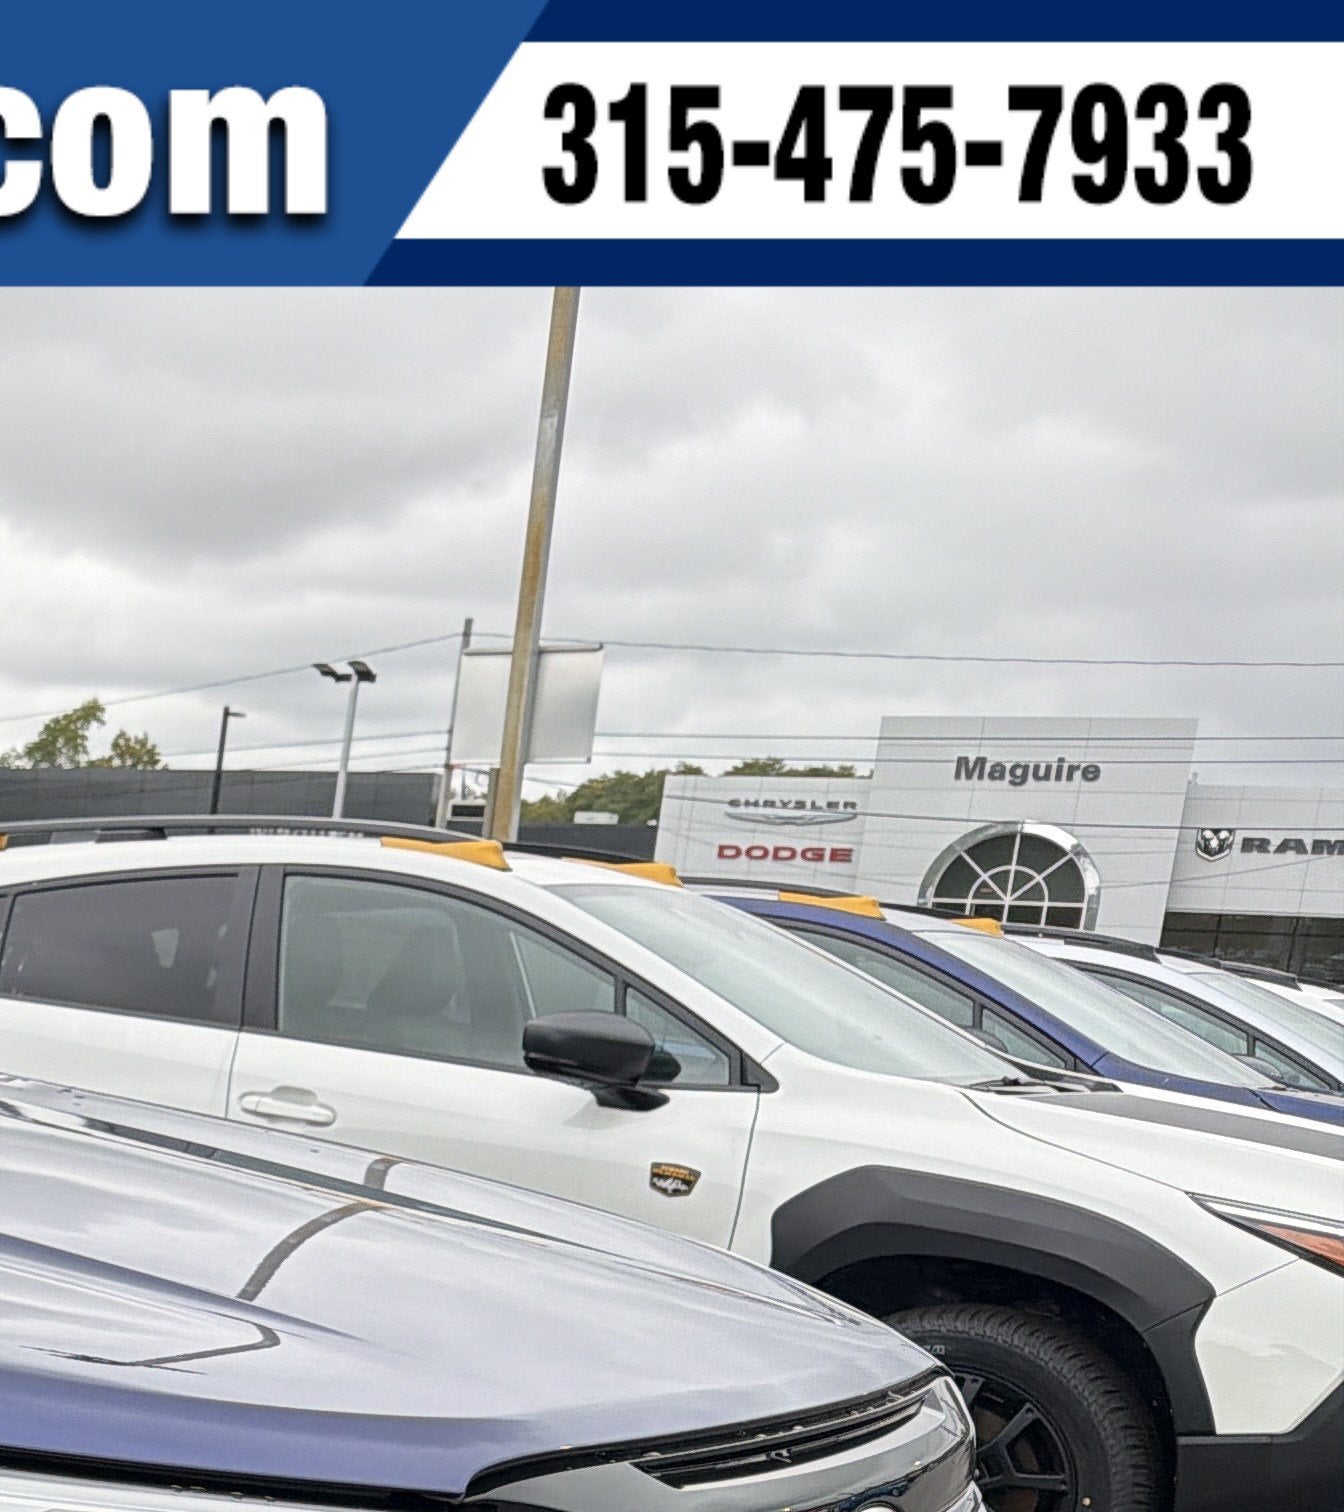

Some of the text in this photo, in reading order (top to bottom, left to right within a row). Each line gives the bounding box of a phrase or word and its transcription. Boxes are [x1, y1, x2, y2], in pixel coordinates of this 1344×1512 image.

[953, 755, 1102, 787] Maguire
[727, 798, 858, 811] CHRYSLER
[717, 844, 854, 863] DODGE
[1240, 836, 1344, 856] RAM
